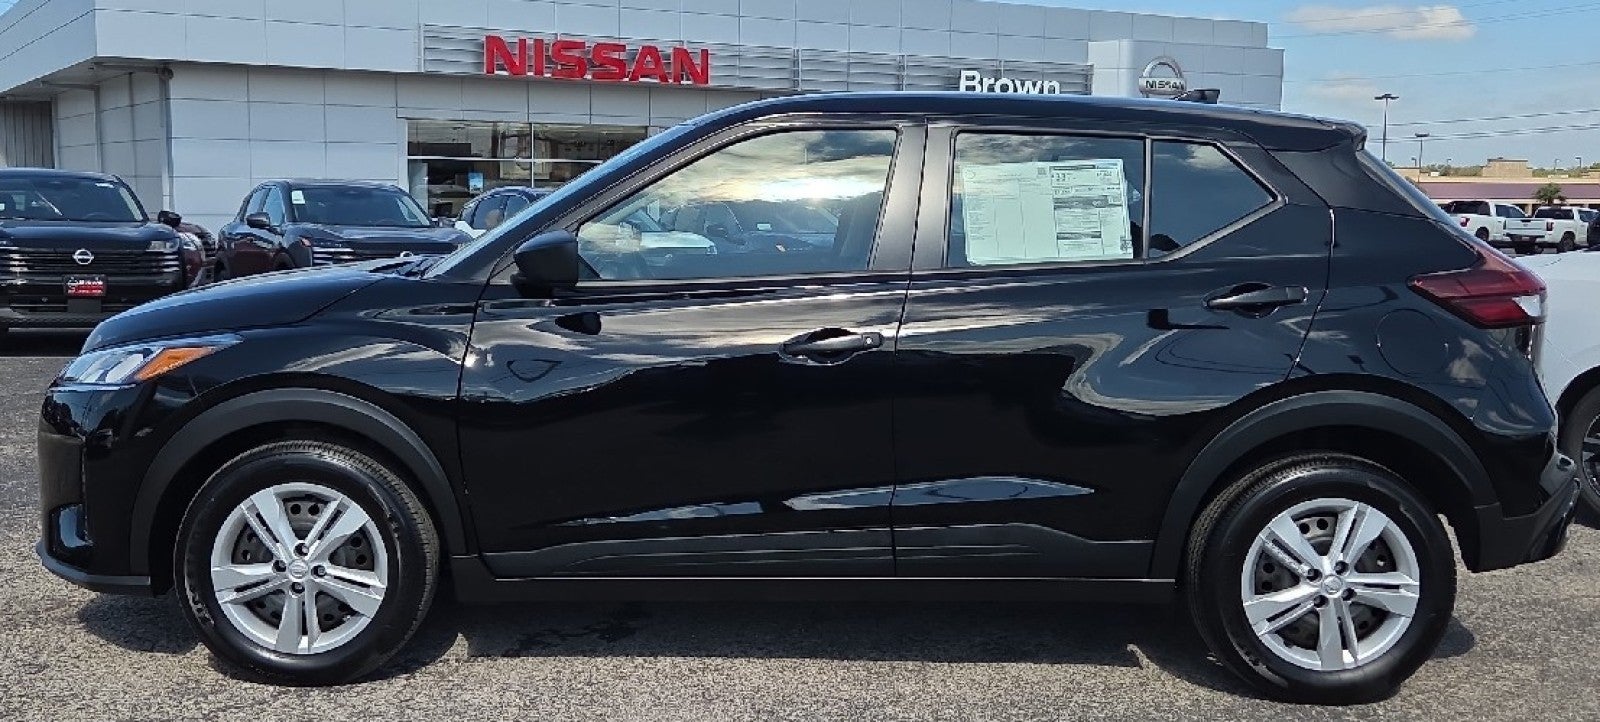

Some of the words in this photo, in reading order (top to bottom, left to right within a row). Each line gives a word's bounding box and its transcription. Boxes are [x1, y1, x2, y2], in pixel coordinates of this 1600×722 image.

[484, 35, 709, 84] NISSAN
[959, 70, 1060, 93] Brown
[1145, 80, 1185, 91] NISSAN
